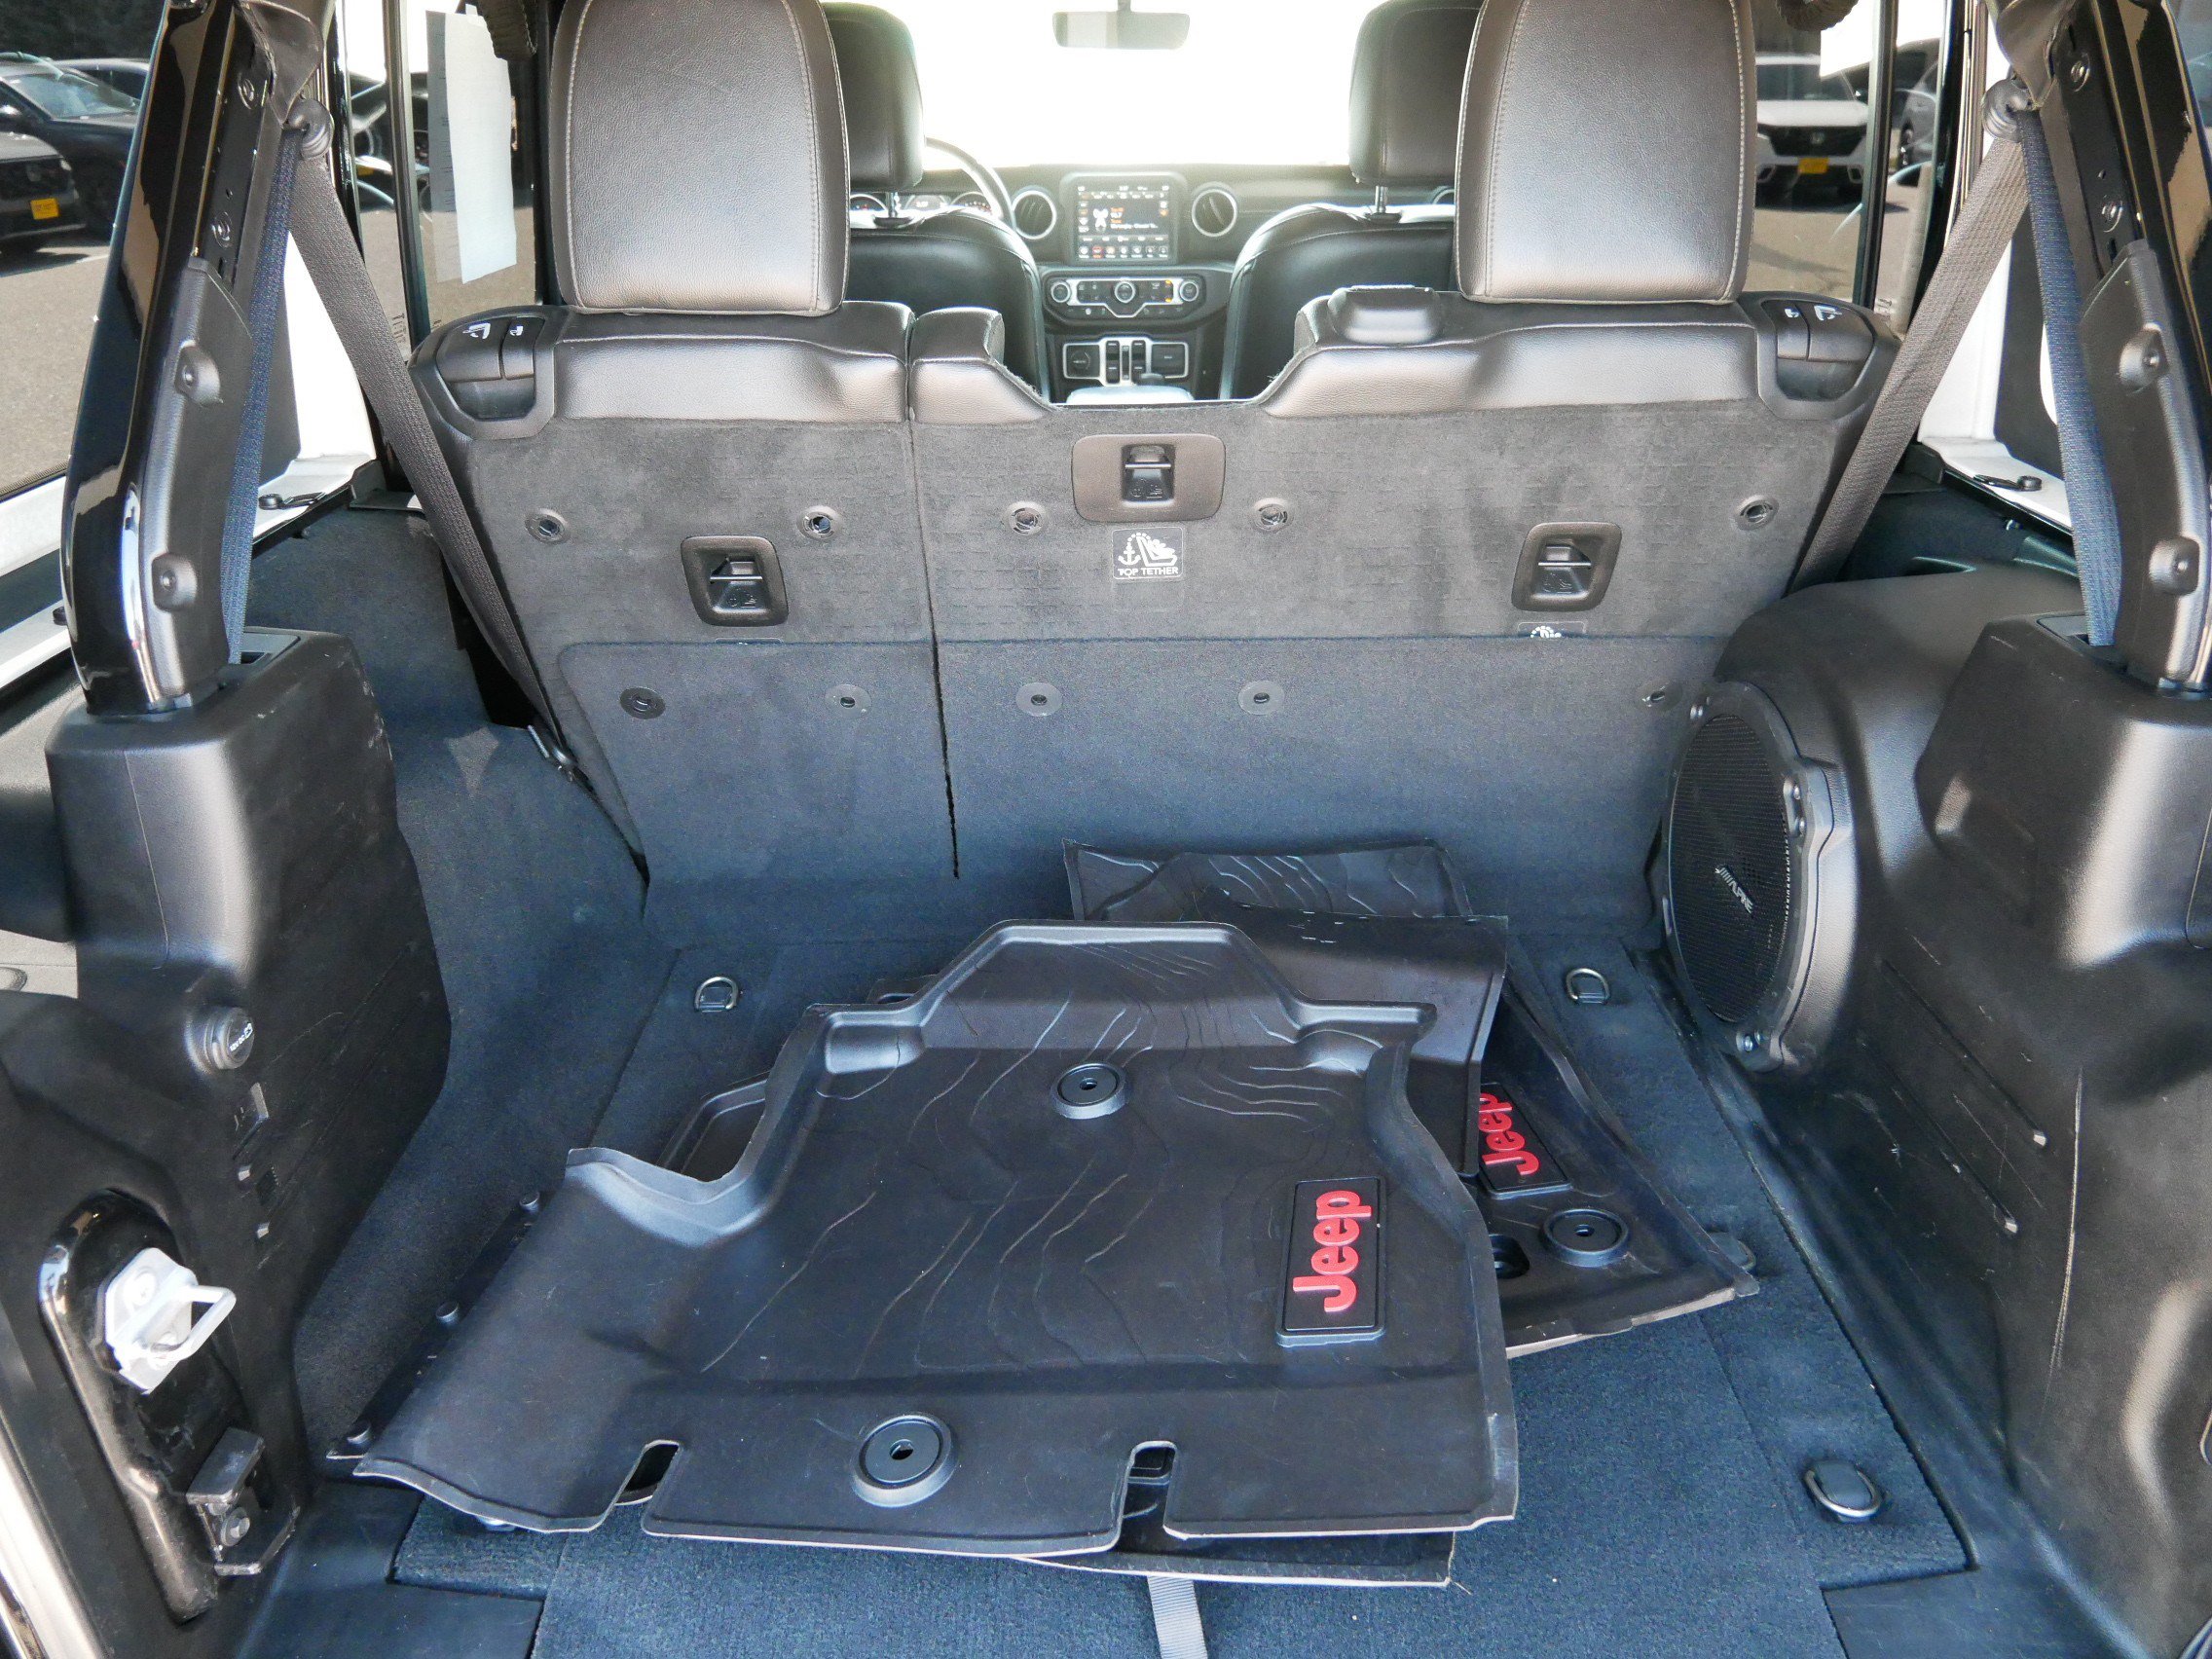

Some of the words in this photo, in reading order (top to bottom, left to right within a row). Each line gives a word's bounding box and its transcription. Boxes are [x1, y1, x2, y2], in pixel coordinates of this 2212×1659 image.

[1118, 568, 1138, 576] TOP
[1140, 567, 1179, 575] TETHER
[1478, 1092, 1540, 1176] Jeep
[1292, 1190, 1372, 1312] Jeep
